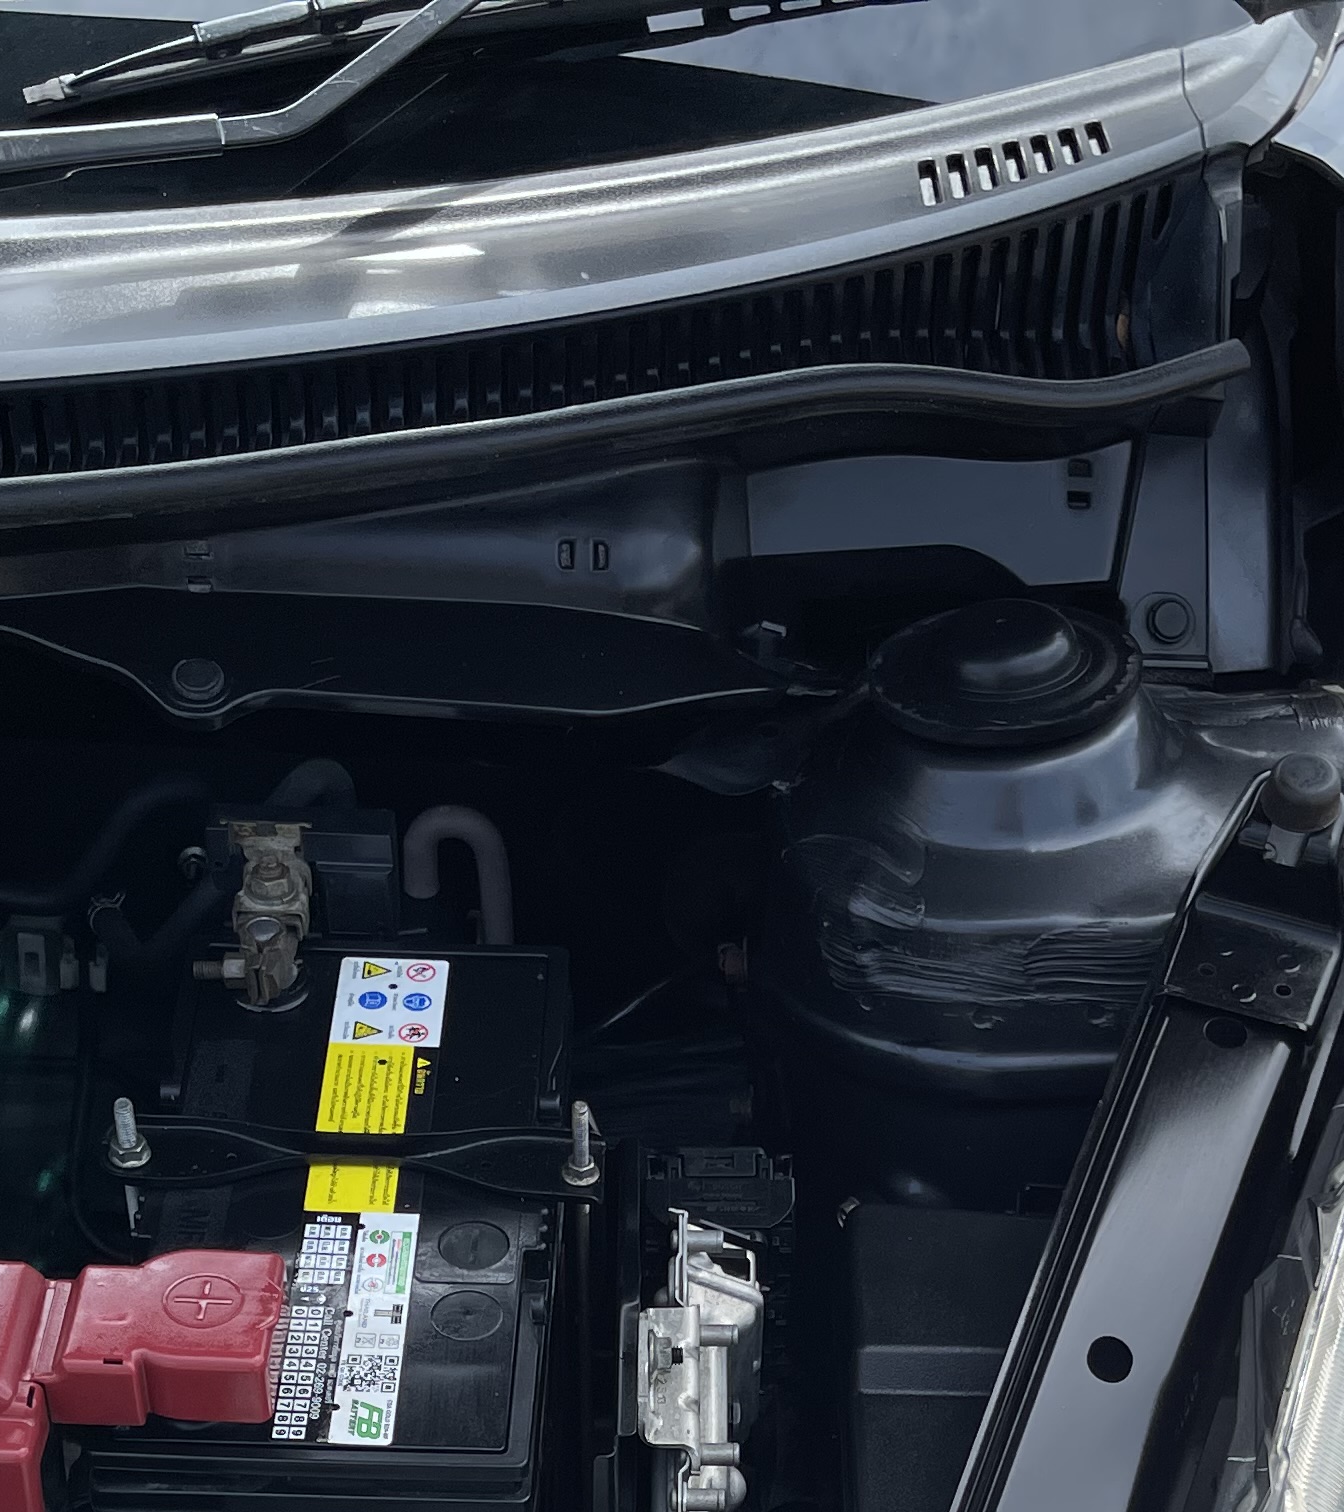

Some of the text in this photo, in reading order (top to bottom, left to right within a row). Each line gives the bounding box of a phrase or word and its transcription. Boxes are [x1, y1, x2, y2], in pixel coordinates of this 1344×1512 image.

[323, 1306, 336, 1326] Call
[318, 1328, 332, 1360] Center
[309, 1362, 327, 1420] 02-269-9009
[348, 1398, 360, 1436] BATTERY
[356, 1401, 384, 1440] FB
